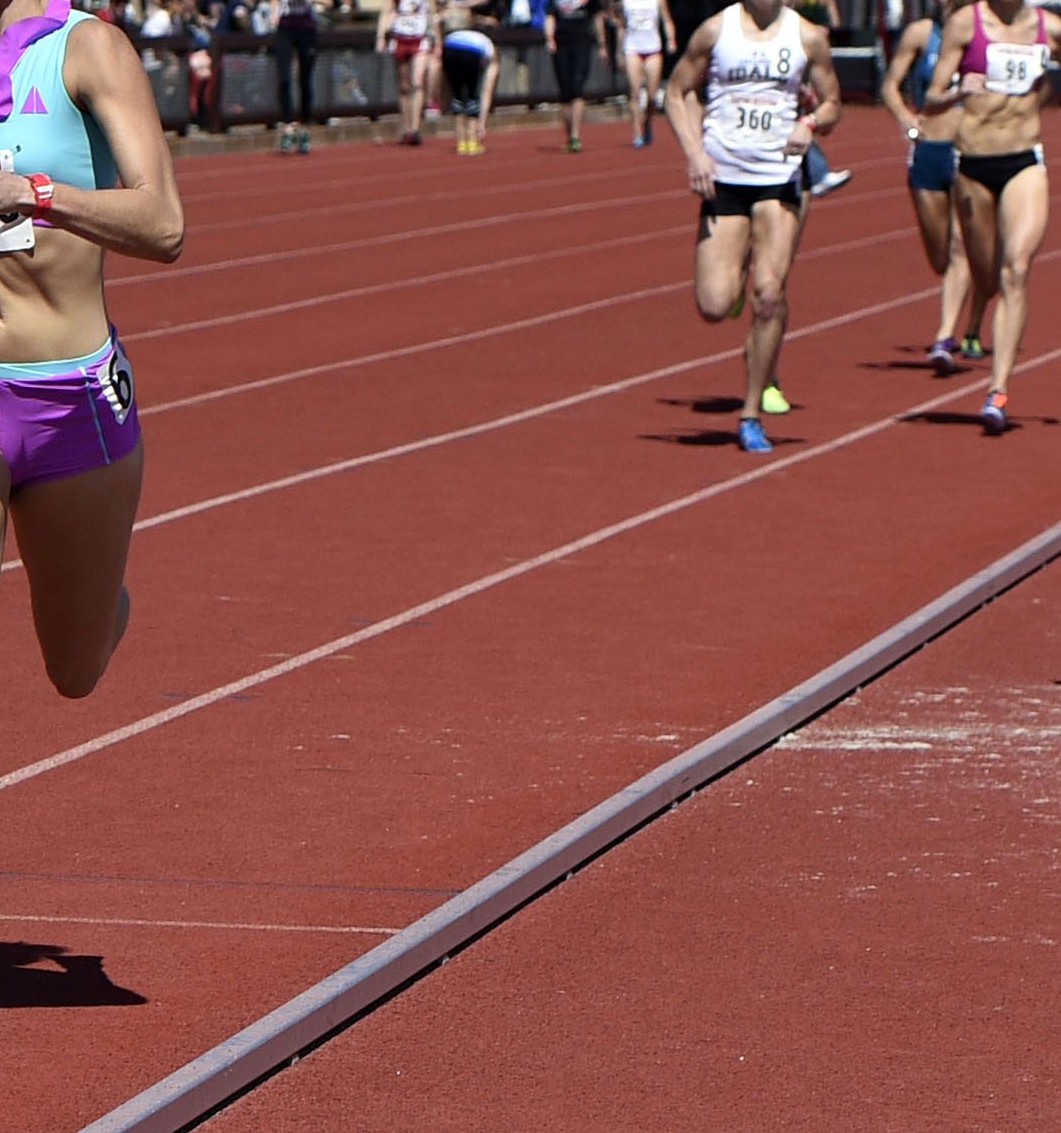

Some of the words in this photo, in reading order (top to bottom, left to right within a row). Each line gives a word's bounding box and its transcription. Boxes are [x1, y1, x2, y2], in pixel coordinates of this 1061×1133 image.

[777, 48, 791, 74] 8
[1005, 59, 1027, 81] 98
[736, 107, 772, 131] 360
[109, 350, 131, 409] 6
